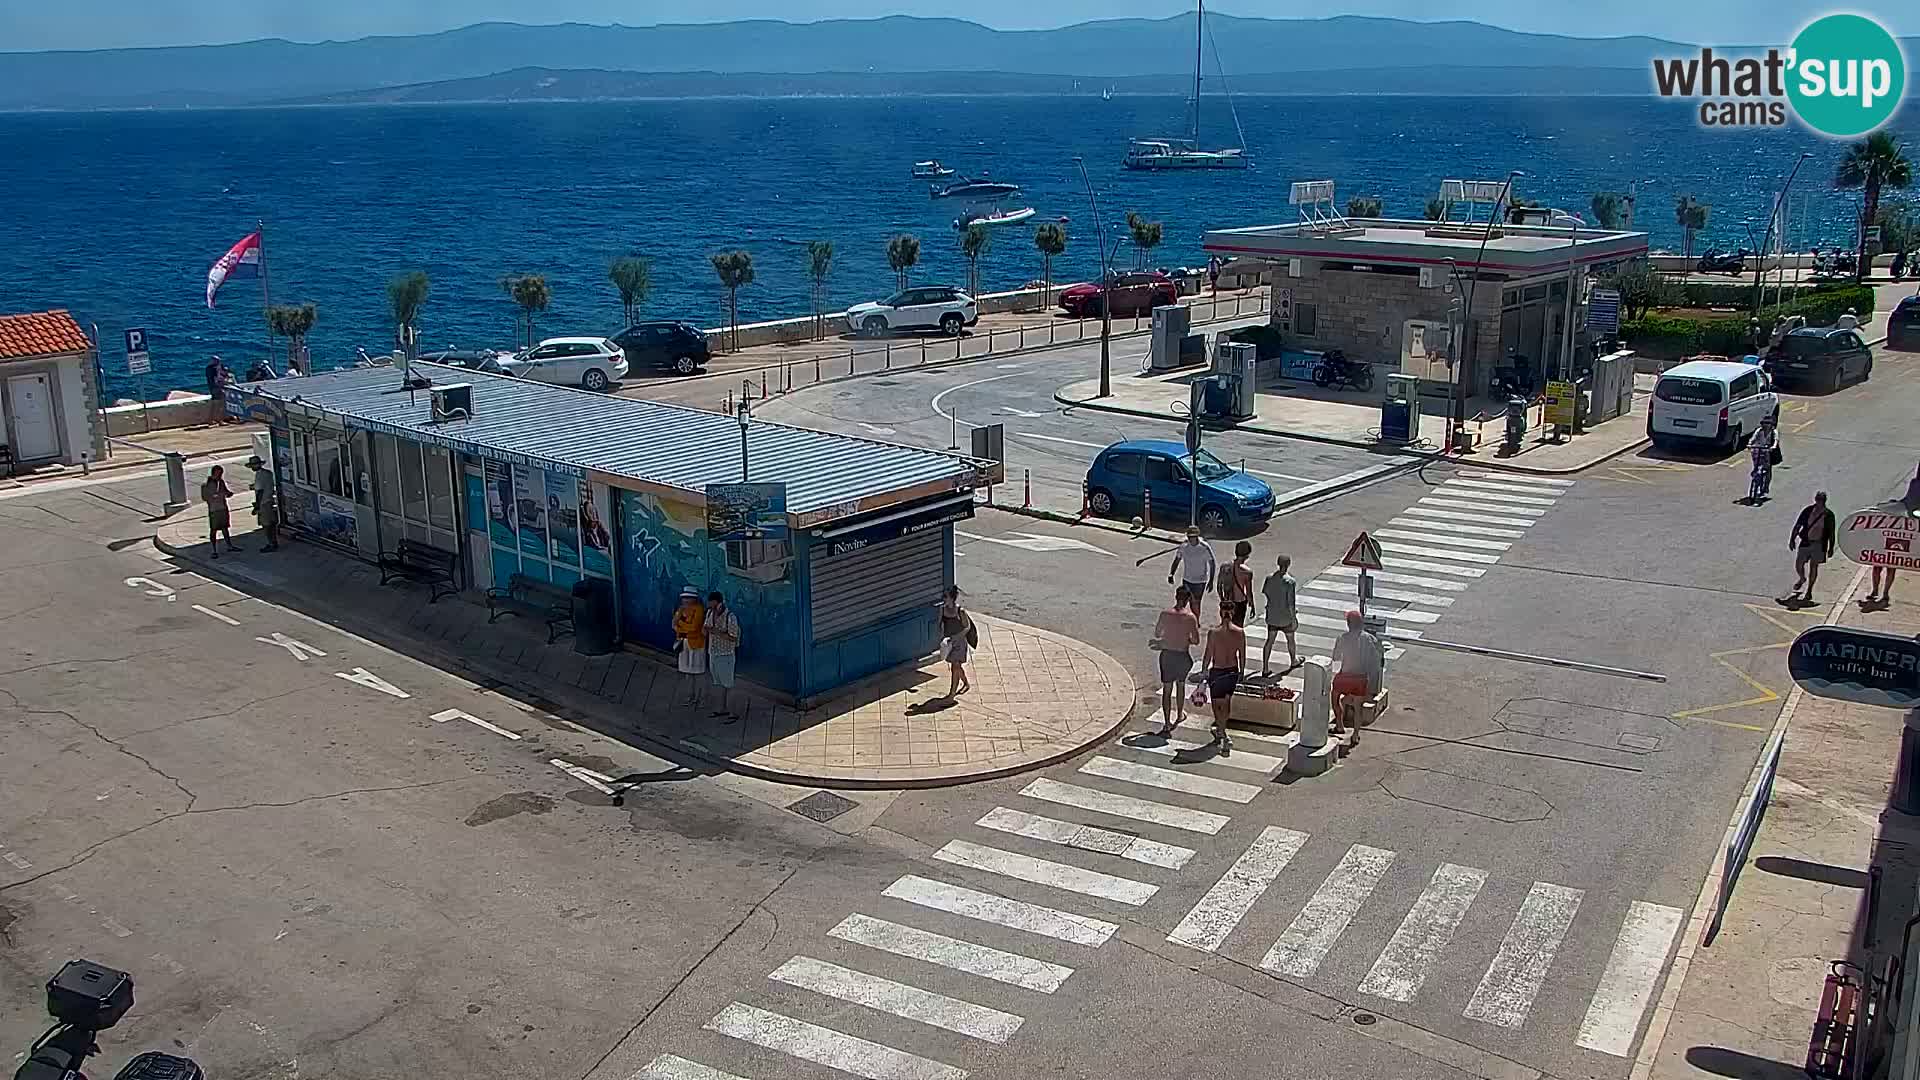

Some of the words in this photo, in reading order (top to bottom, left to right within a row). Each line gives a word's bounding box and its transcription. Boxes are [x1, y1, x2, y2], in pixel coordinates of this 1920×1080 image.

[130, 331, 142, 350] P
[436, 437, 467, 451] POSTAJA
[478, 446, 493, 458] BUS
[494, 450, 526, 465] STATION
[527, 457, 554, 470] TICKET
[555, 463, 583, 477] OFFICE
[1848, 515, 1920, 533] PIZZE
[1882, 530, 1917, 540] GRILL
[1828, 662, 1867, 674] caffe
[1870, 665, 1897, 680] bar
